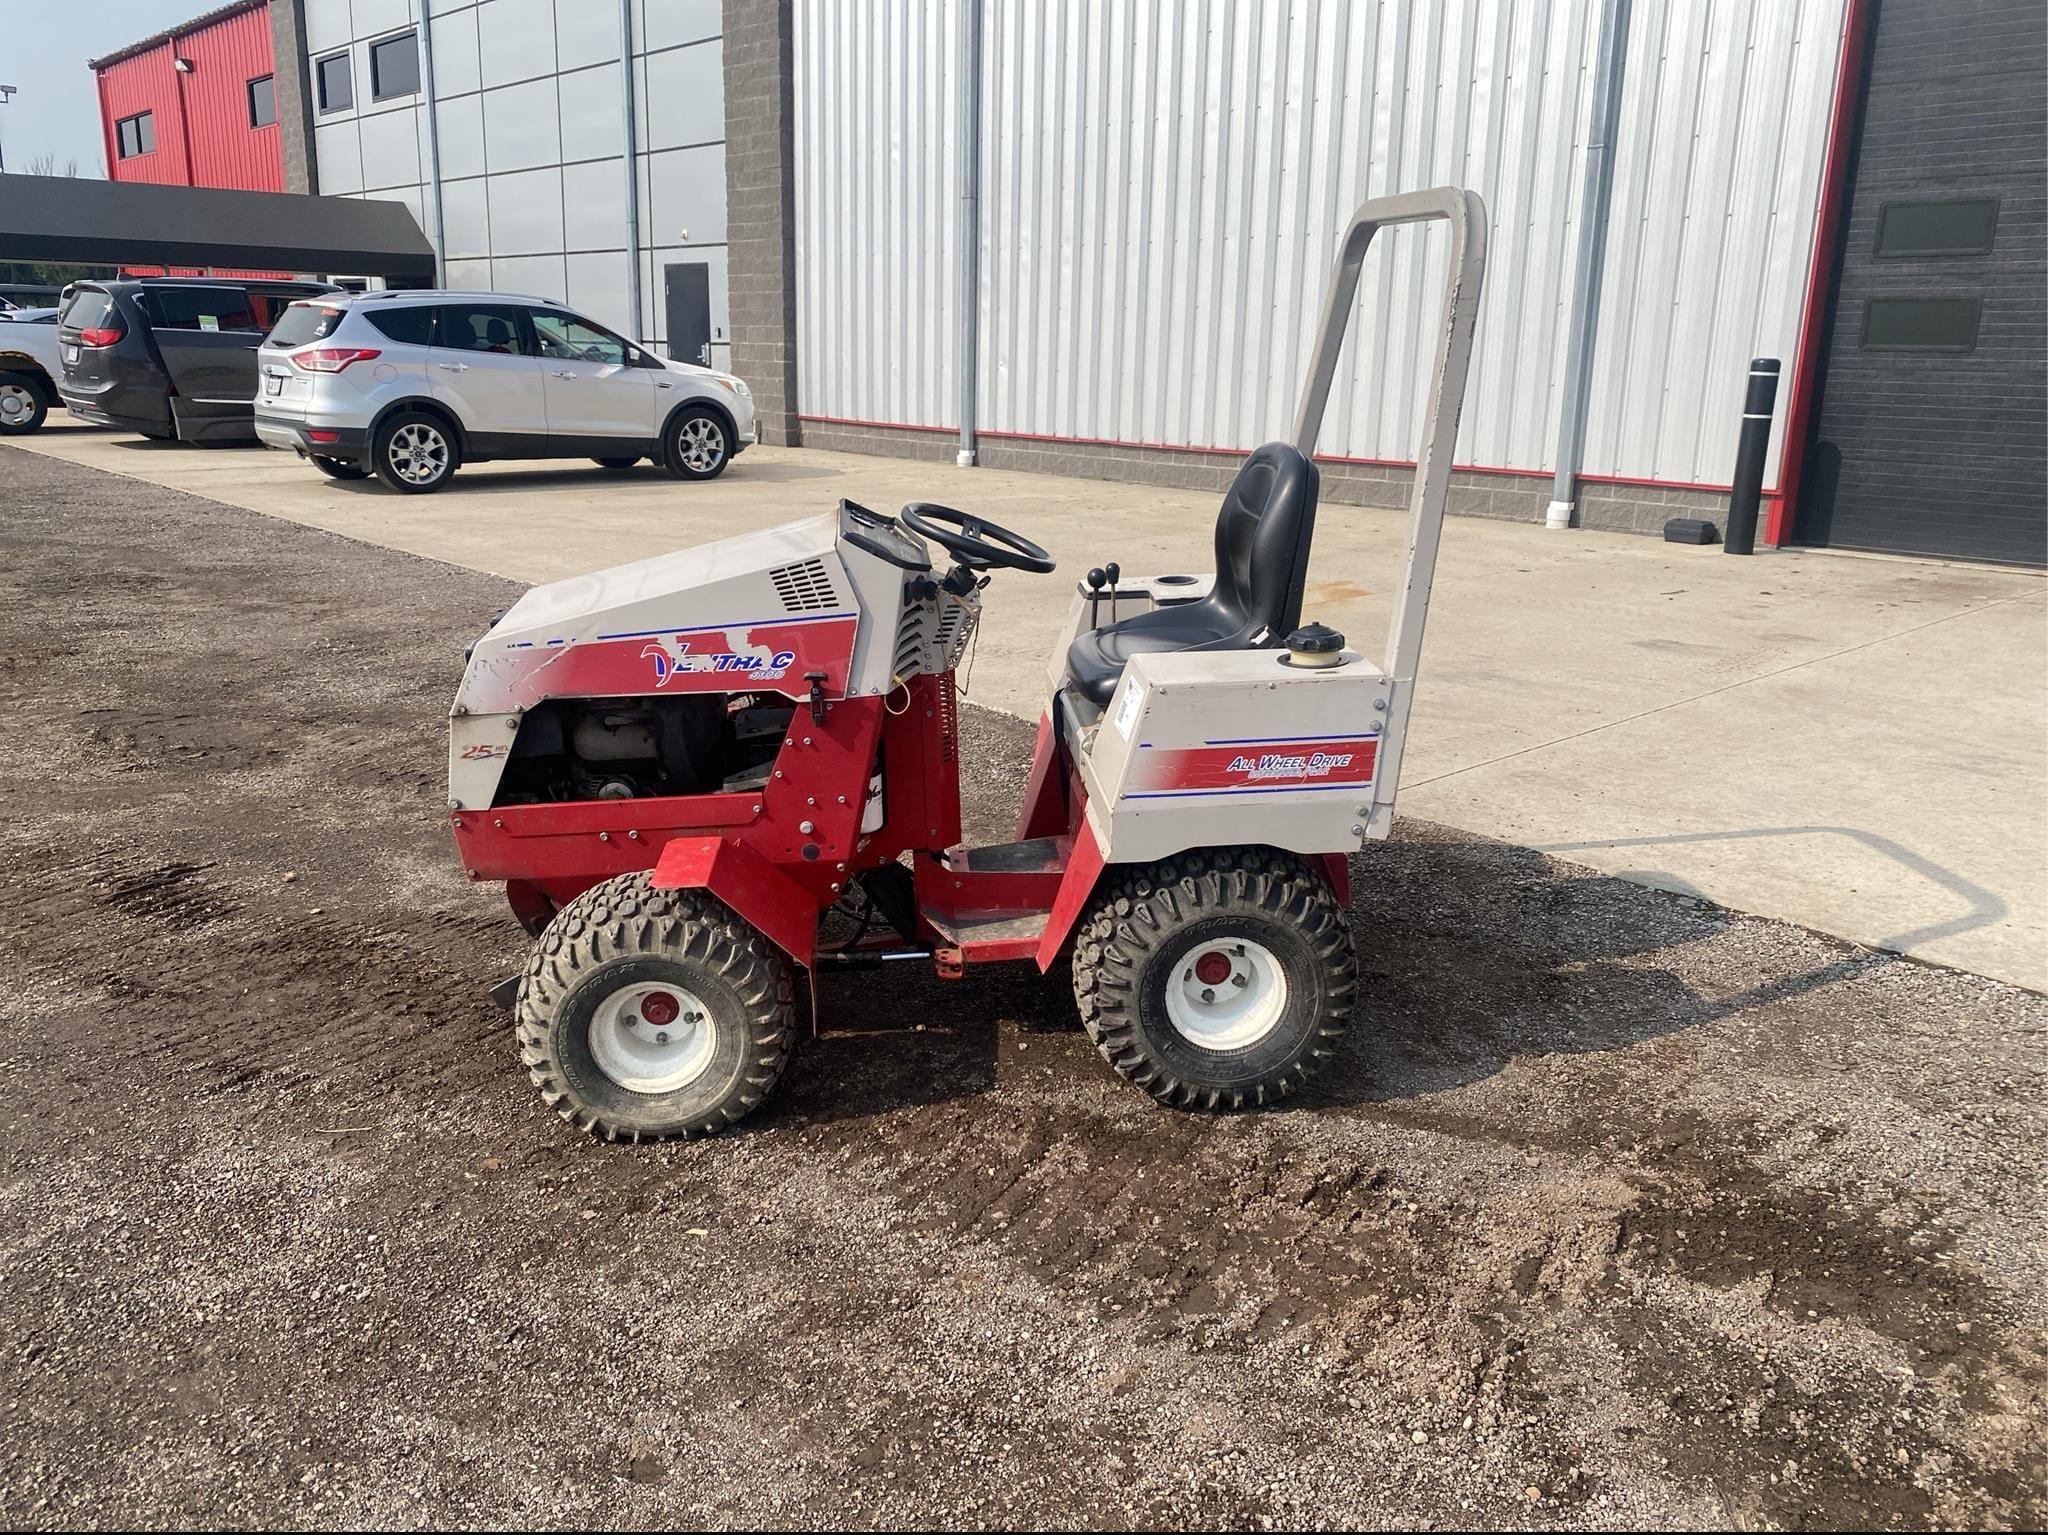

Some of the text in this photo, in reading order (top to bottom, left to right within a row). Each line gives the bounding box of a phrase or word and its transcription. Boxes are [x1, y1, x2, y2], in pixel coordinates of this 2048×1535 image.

[461, 744, 492, 760] 25
[1226, 752, 1352, 772] ALL WHEEL DRIVE
